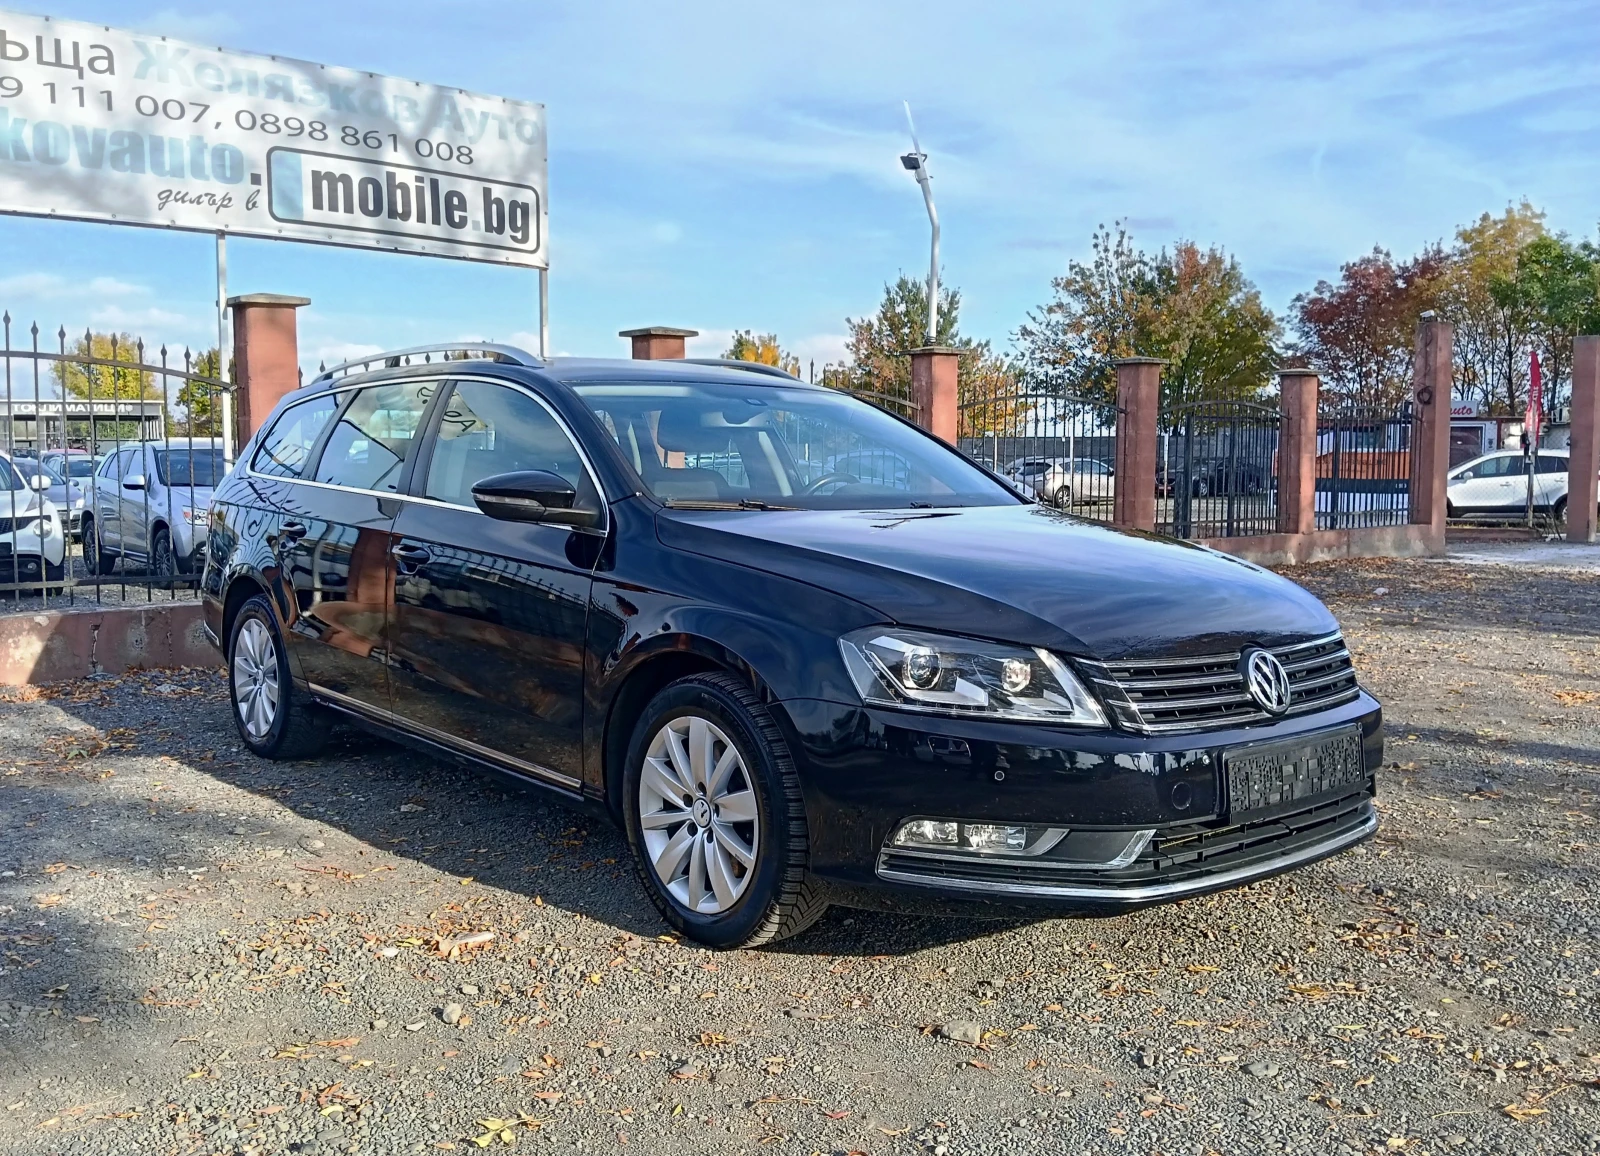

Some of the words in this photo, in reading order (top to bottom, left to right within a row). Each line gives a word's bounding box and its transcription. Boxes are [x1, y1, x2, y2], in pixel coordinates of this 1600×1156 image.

[43, 82, 113, 111] 111
[133, 95, 222, 129] 007,
[234, 110, 329, 142] 0898
[340, 125, 398, 152] 861
[414, 138, 474, 165] 008
[311, 169, 530, 245] mobile.bg
[1450, 405, 1473, 415] uto
